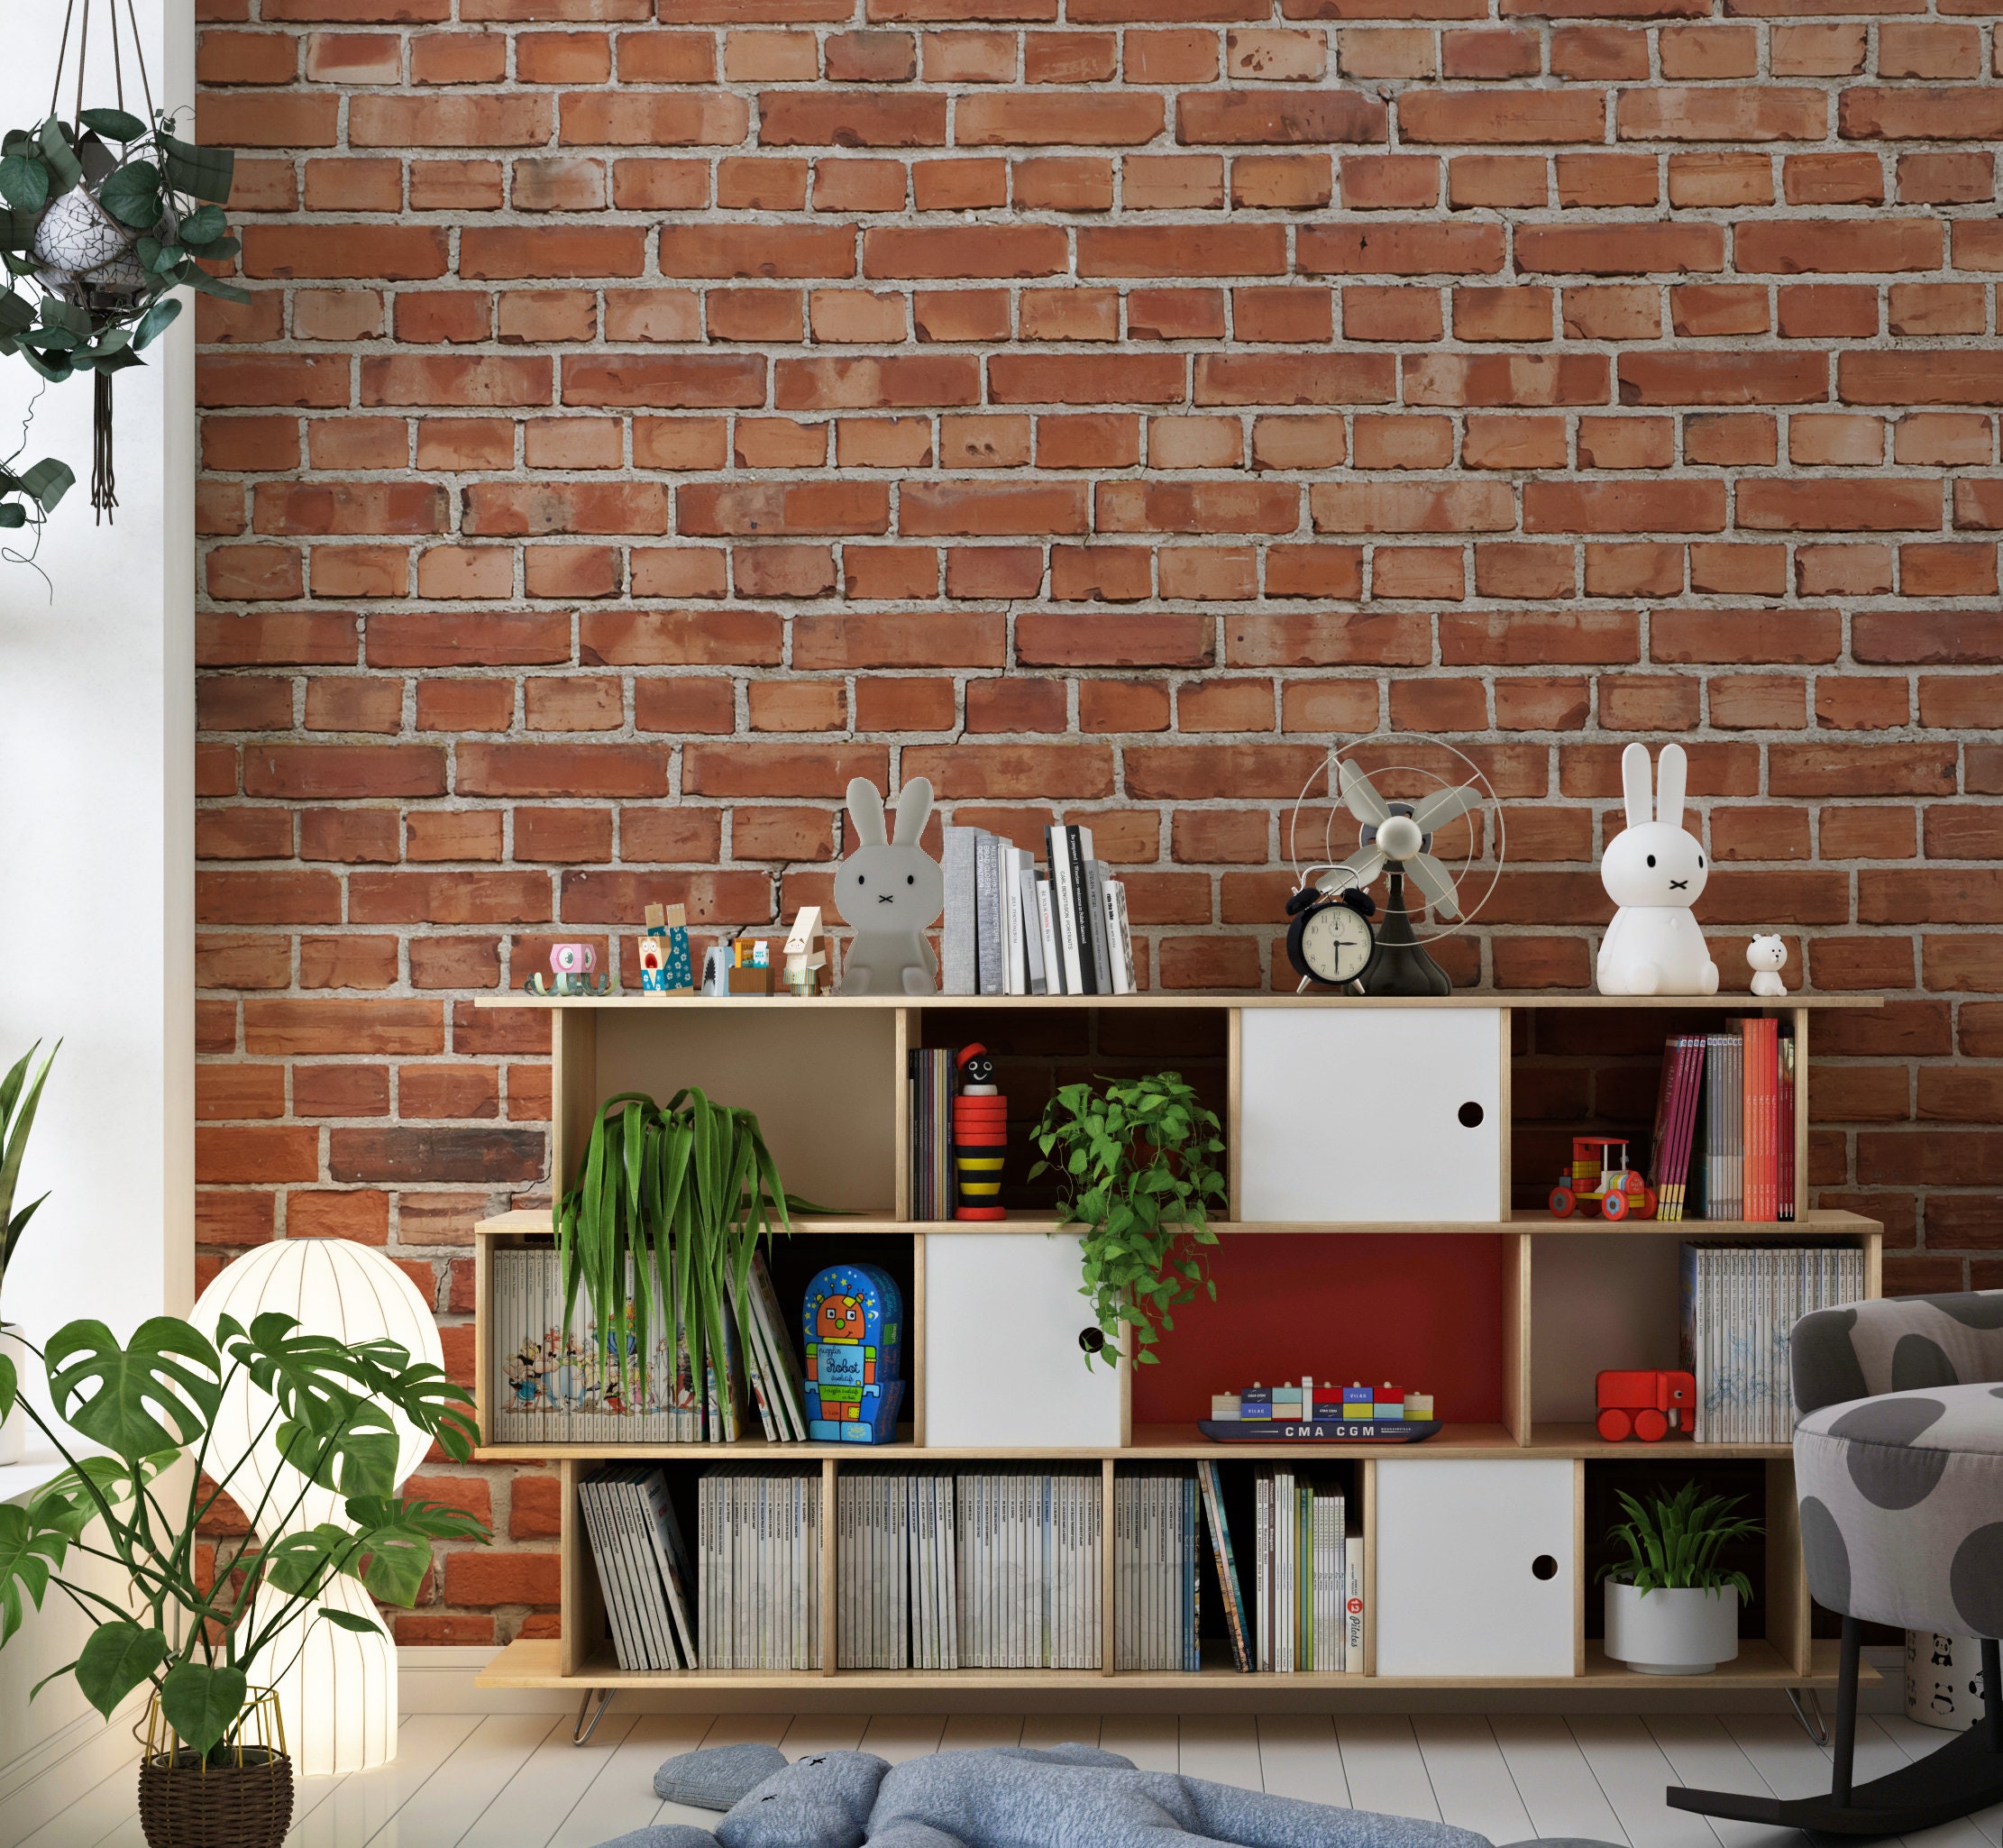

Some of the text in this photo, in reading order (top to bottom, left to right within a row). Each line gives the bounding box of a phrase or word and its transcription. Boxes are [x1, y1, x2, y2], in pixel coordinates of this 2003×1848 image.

[1061, 886, 1069, 918] BENGTSSON
[1312, 926, 1318, 934] 10
[1307, 940, 1312, 948] 9
[1362, 939, 1367, 947] 3
[1311, 954, 1315, 962] 8
[1322, 965, 1326, 973] 7
[1350, 965, 1354, 973] 5
[827, 1359, 860, 1373] Robot
[1285, 1427, 1375, 1436] CMA CGM
[1351, 1600, 1359, 1612] 12
[1349, 1616, 1360, 1648] Pilotes
